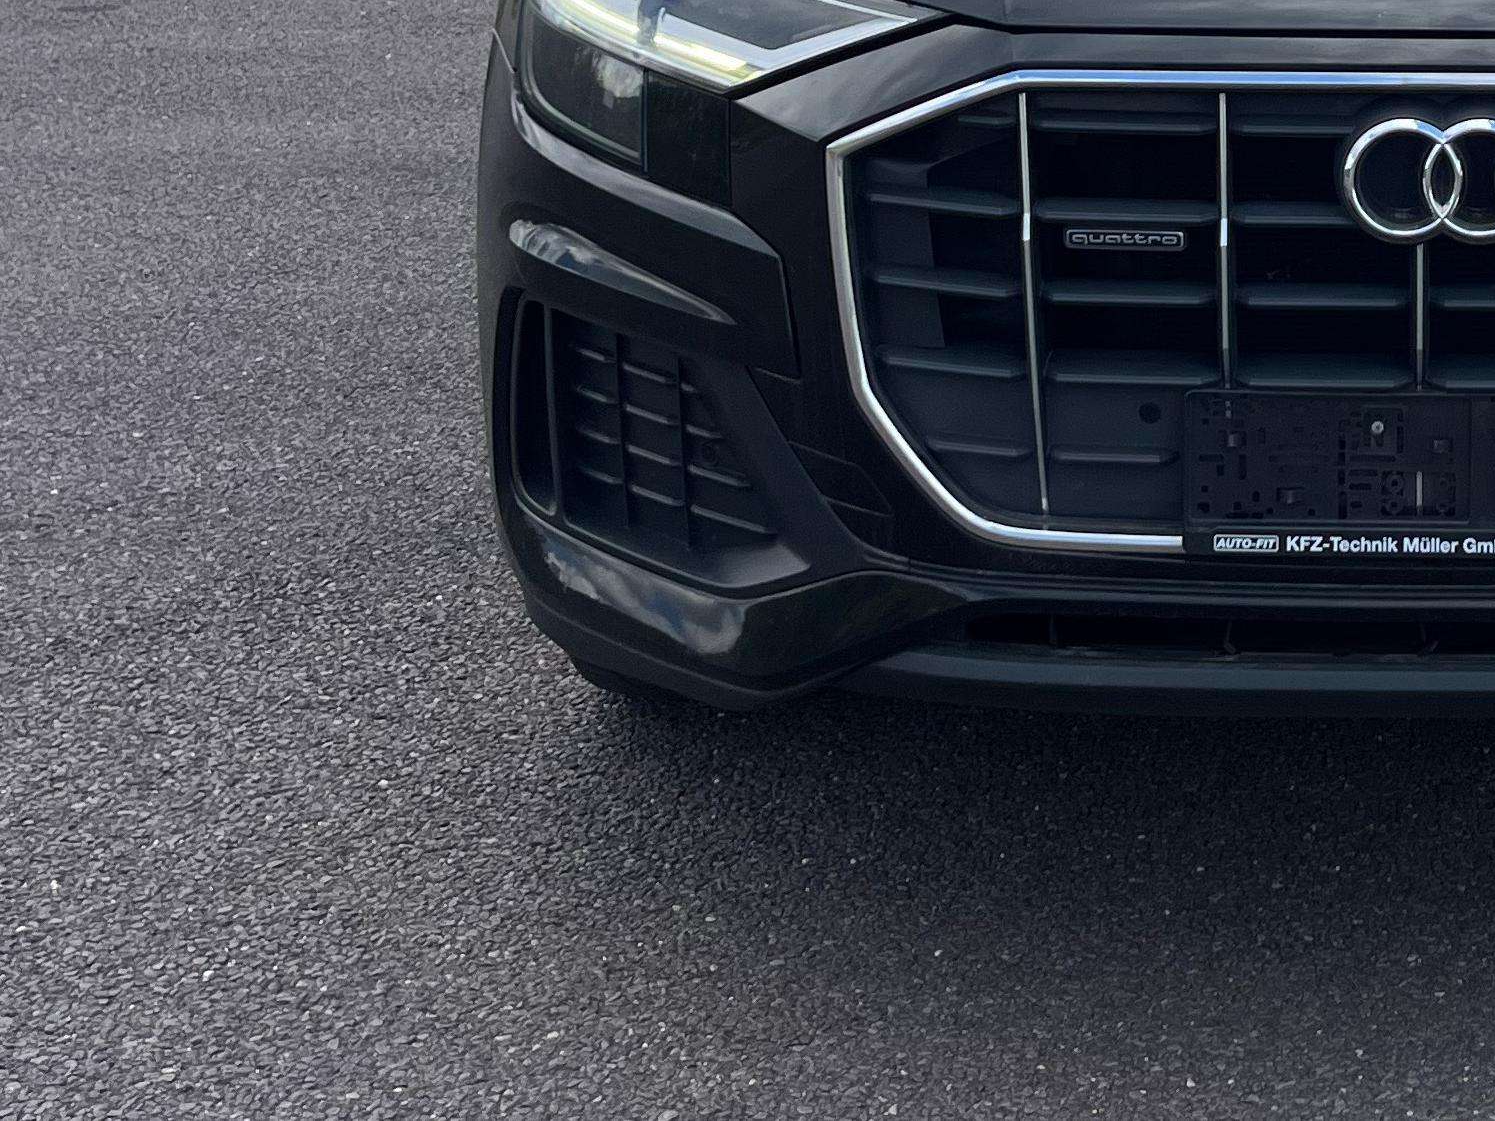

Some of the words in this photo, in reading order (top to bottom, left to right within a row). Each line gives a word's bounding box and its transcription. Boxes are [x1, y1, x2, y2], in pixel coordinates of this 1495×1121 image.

[1071, 233, 1178, 246] quattro
[1215, 537, 1277, 549] AUTO-FIT
[1286, 536, 1398, 553] KFZ-Technik
[1402, 536, 1457, 553] Müller
